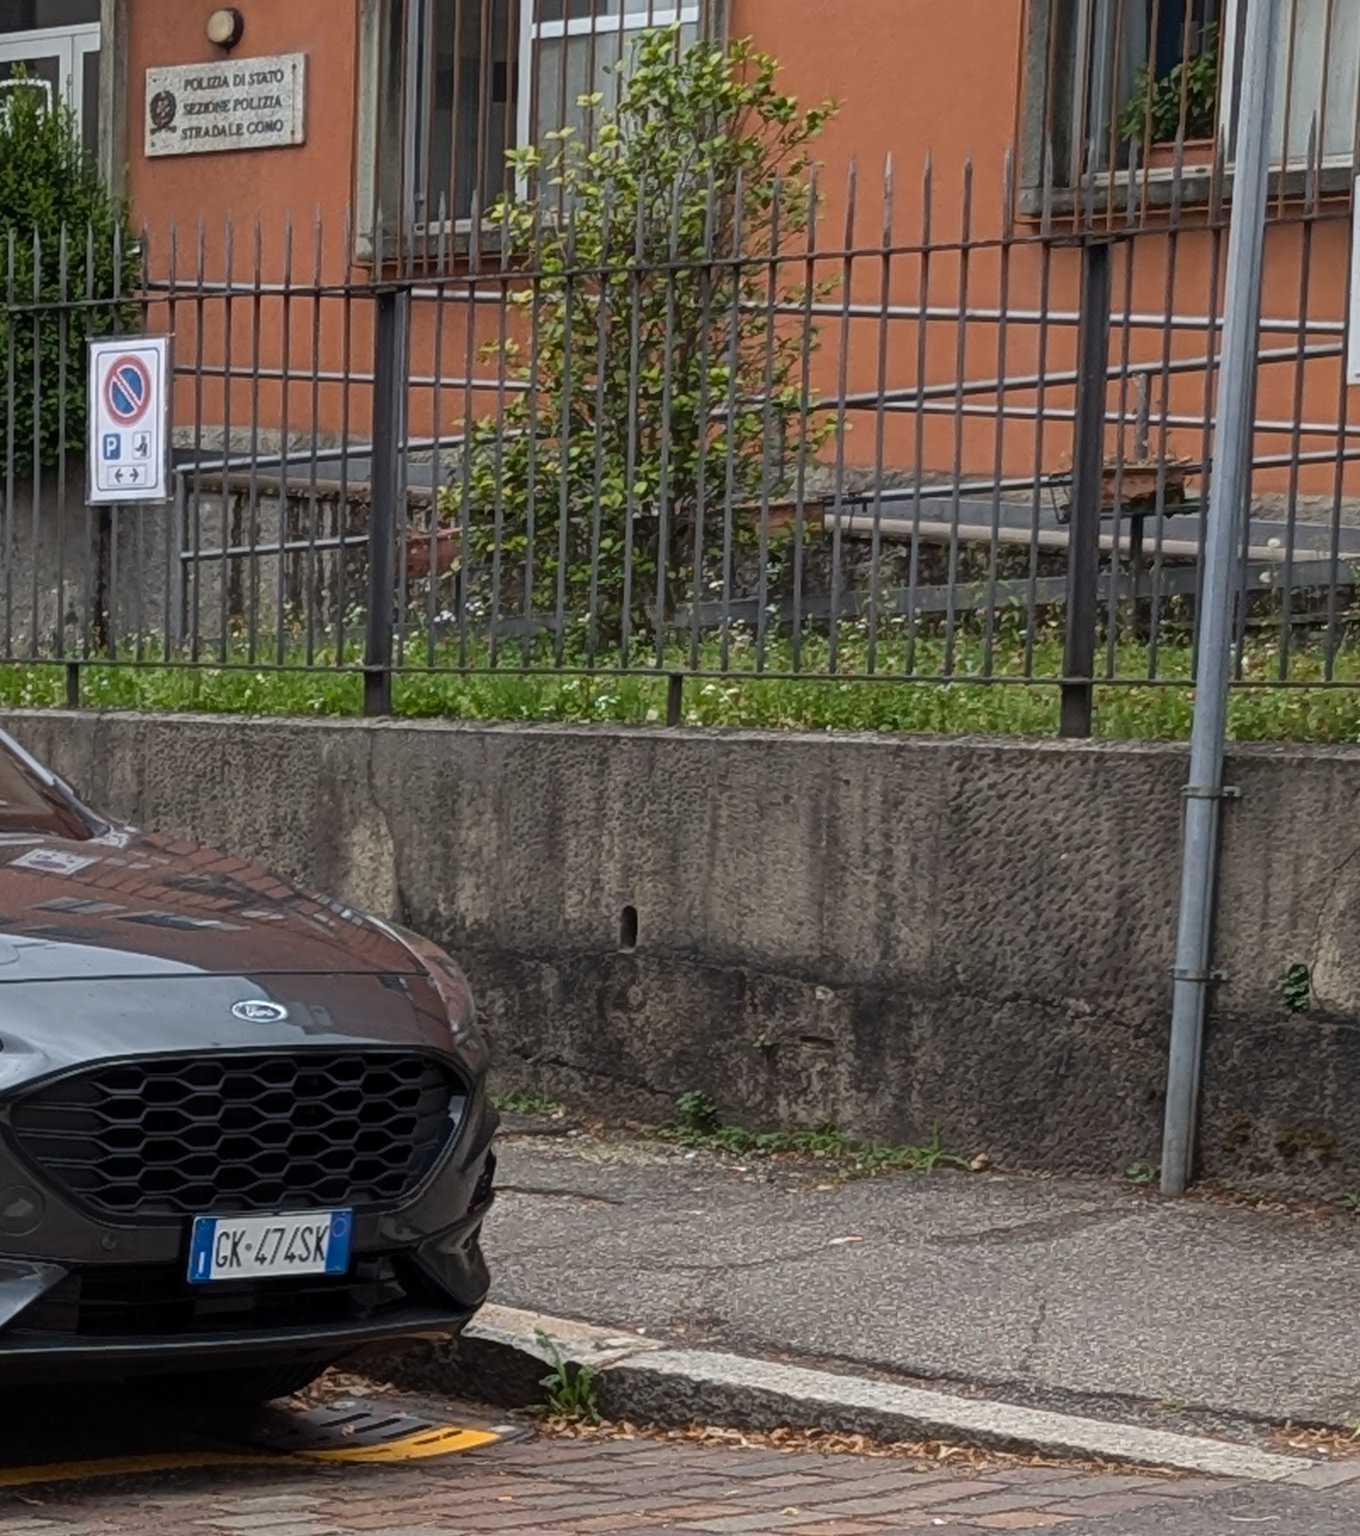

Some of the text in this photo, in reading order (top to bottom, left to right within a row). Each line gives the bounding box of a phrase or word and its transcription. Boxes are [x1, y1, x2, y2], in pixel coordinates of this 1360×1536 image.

[183, 69, 284, 92] POLIZIA DI STATO
[183, 95, 283, 115] SEZIONE POLIZIA
[181, 119, 284, 140] STRADALE COMO
[106, 437, 117, 457] P
